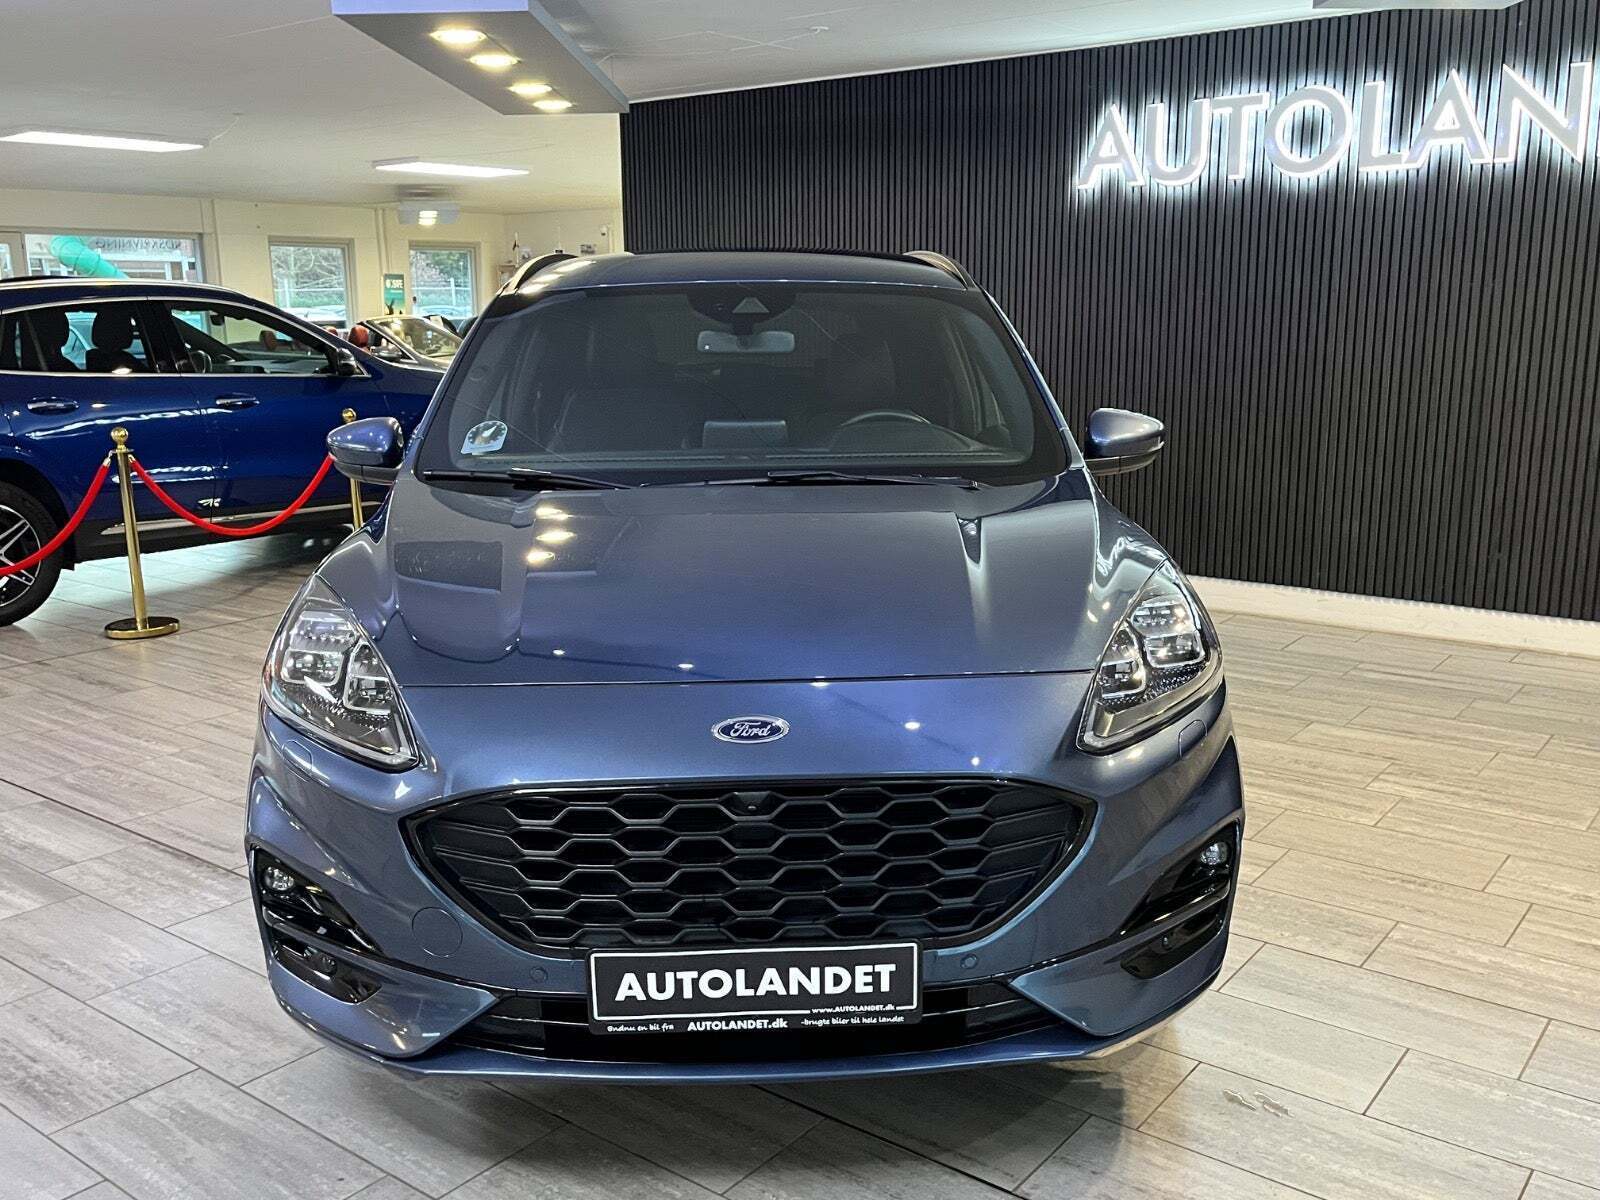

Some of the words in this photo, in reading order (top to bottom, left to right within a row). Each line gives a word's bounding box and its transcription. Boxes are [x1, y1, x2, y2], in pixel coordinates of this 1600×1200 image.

[1076, 61, 1600, 190] AUTOLAN
[730, 721, 772, 738] Ford
[614, 963, 897, 1001] AUTOLANDET
[811, 1003, 895, 1014] www.AUTOLANDET.dk
[687, 1018, 788, 1031] AUTOLANDET.dk
